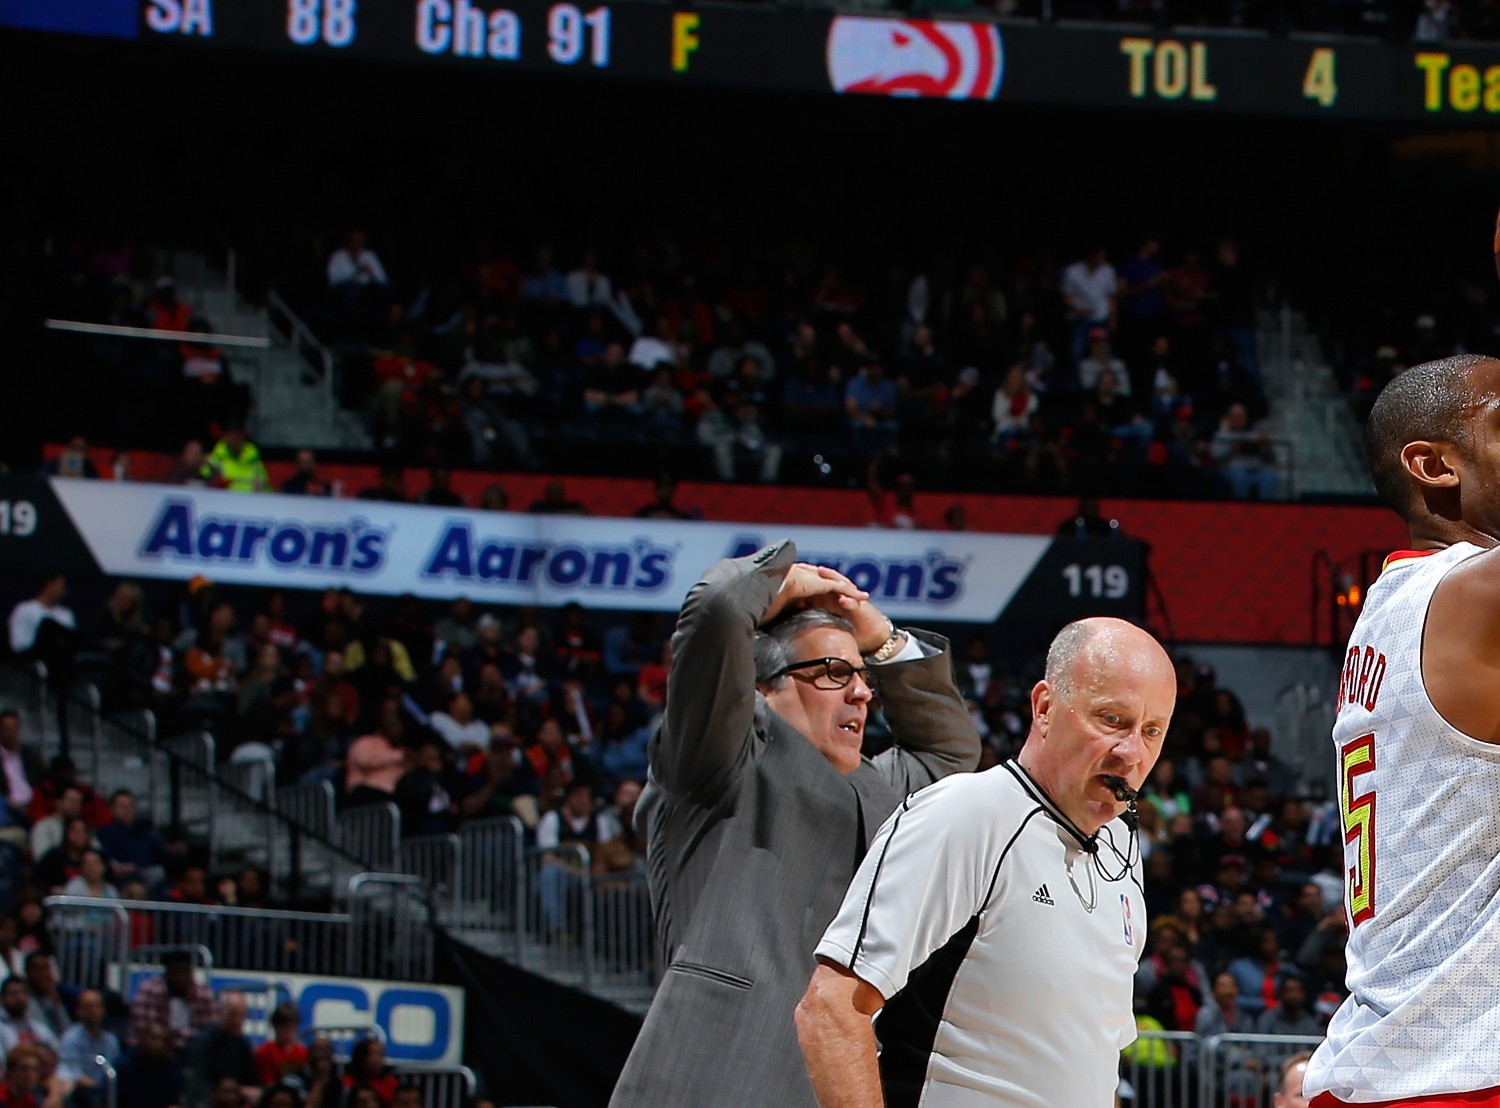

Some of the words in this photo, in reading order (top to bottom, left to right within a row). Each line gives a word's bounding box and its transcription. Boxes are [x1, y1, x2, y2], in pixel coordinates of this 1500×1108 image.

[286, 0, 356, 47] 88
[415, 0, 521, 59] Cha
[546, 3, 611, 67] 91
[671, 12, 699, 72] F
[1121, 38, 1216, 101] TOL
[1303, 47, 1338, 107] 4
[140, 500, 388, 574] Aaron's
[421, 520, 673, 592] Aaron's
[1062, 563, 1129, 599] 119
